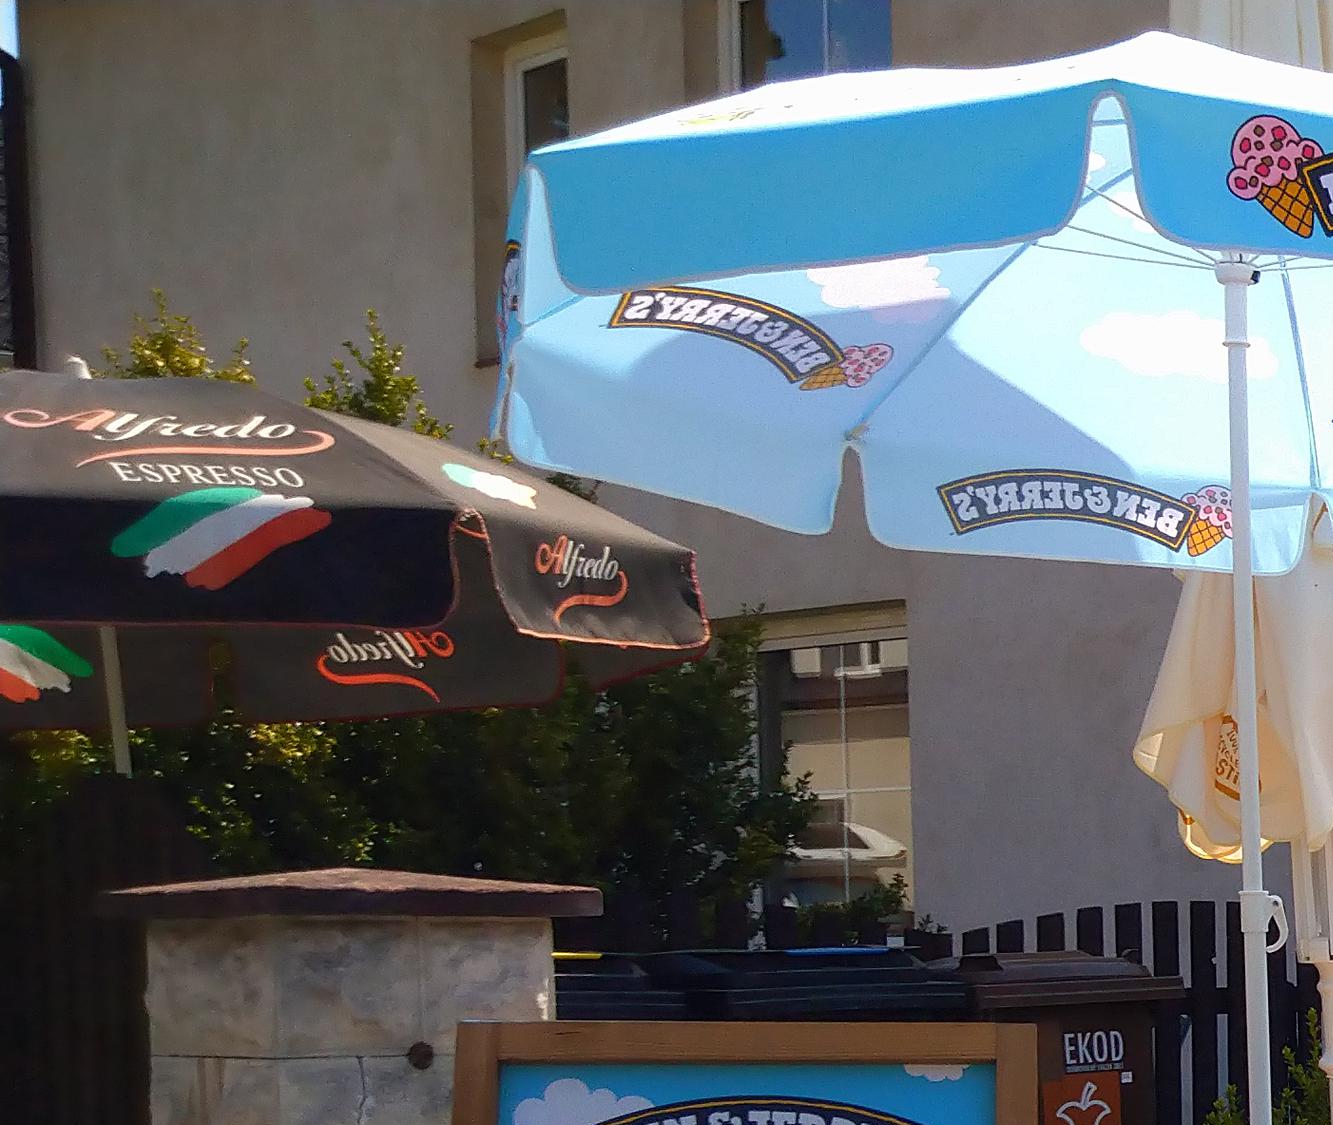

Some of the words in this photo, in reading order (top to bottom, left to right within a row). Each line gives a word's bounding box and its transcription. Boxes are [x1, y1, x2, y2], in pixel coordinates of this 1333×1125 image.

[107, 461, 305, 488] ESPRESSO
[535, 535, 619, 588] Alfredo
[1063, 1030, 1124, 1064] EKOD
